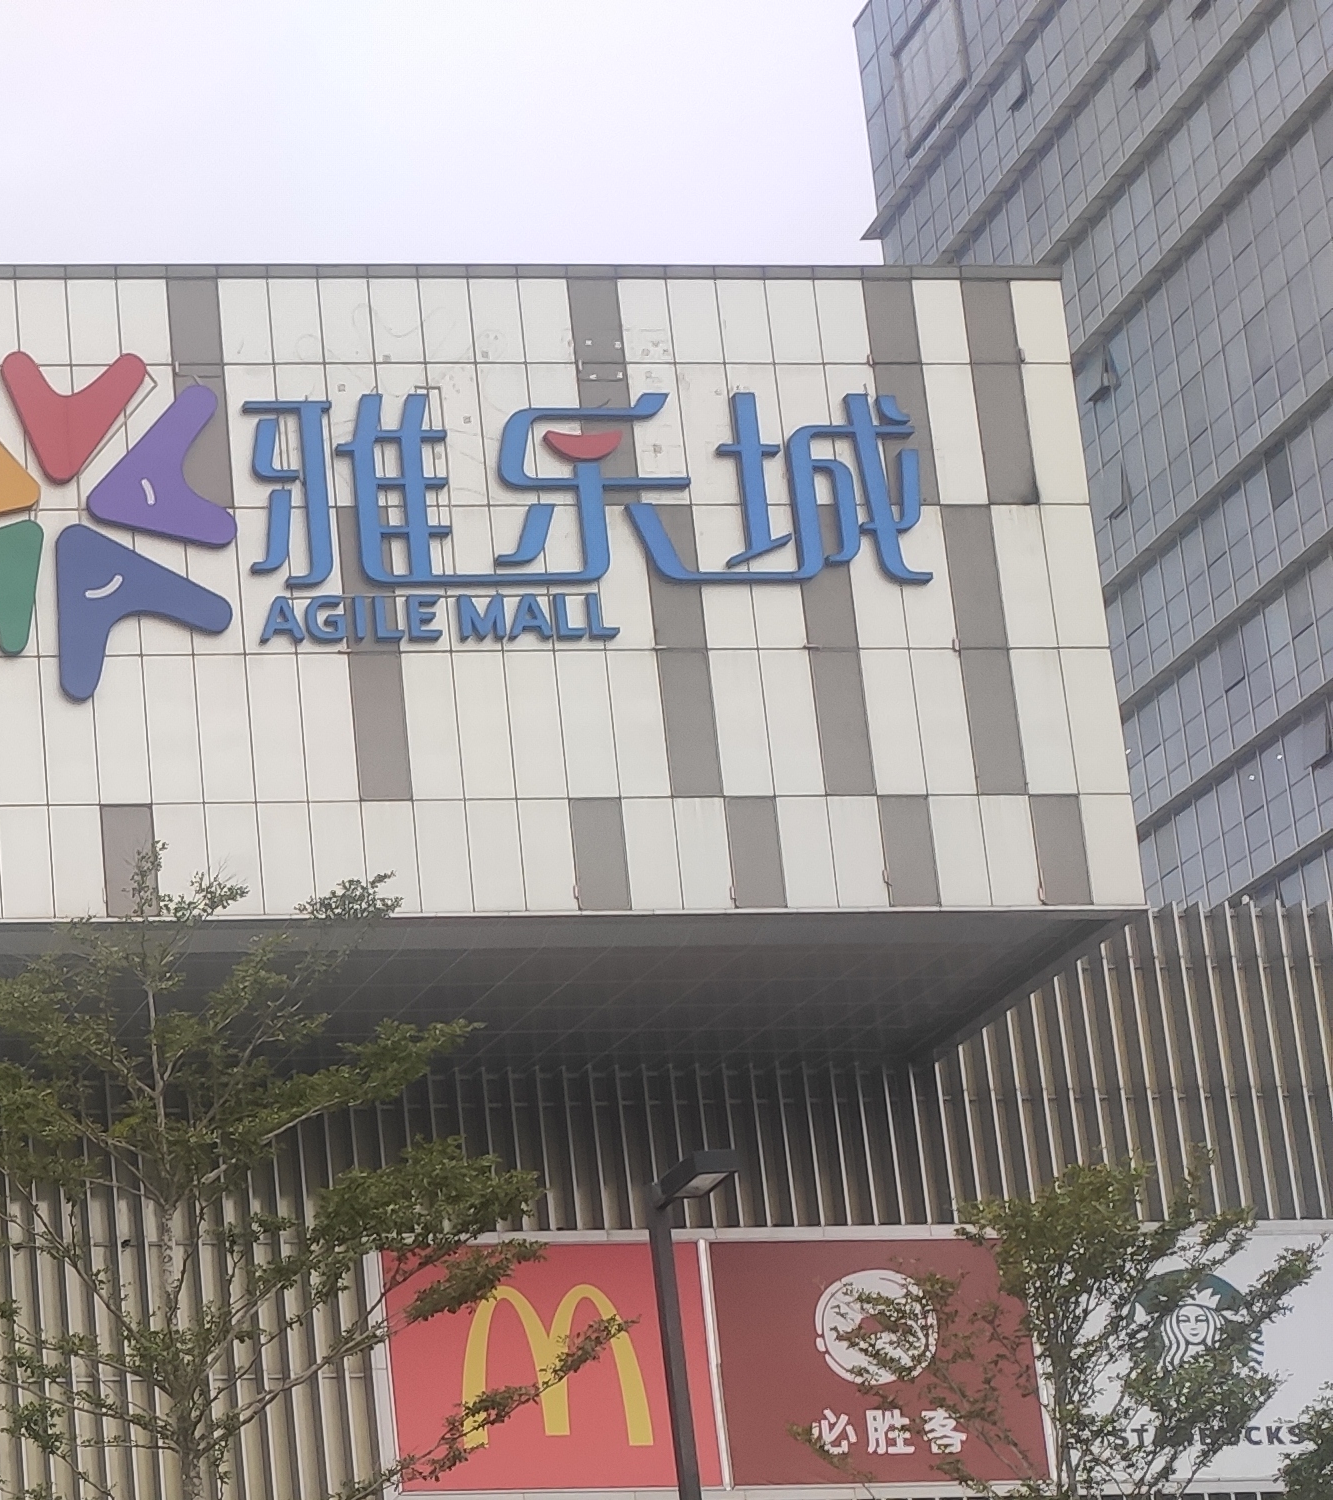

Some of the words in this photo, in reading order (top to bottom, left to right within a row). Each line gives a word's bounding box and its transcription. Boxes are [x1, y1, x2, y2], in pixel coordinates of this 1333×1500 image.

[242, 391, 934, 591] 雅乐城
[259, 592, 443, 646] AGILE
[459, 591, 621, 642] MALL
[811, 1407, 968, 1455] 必胜客
